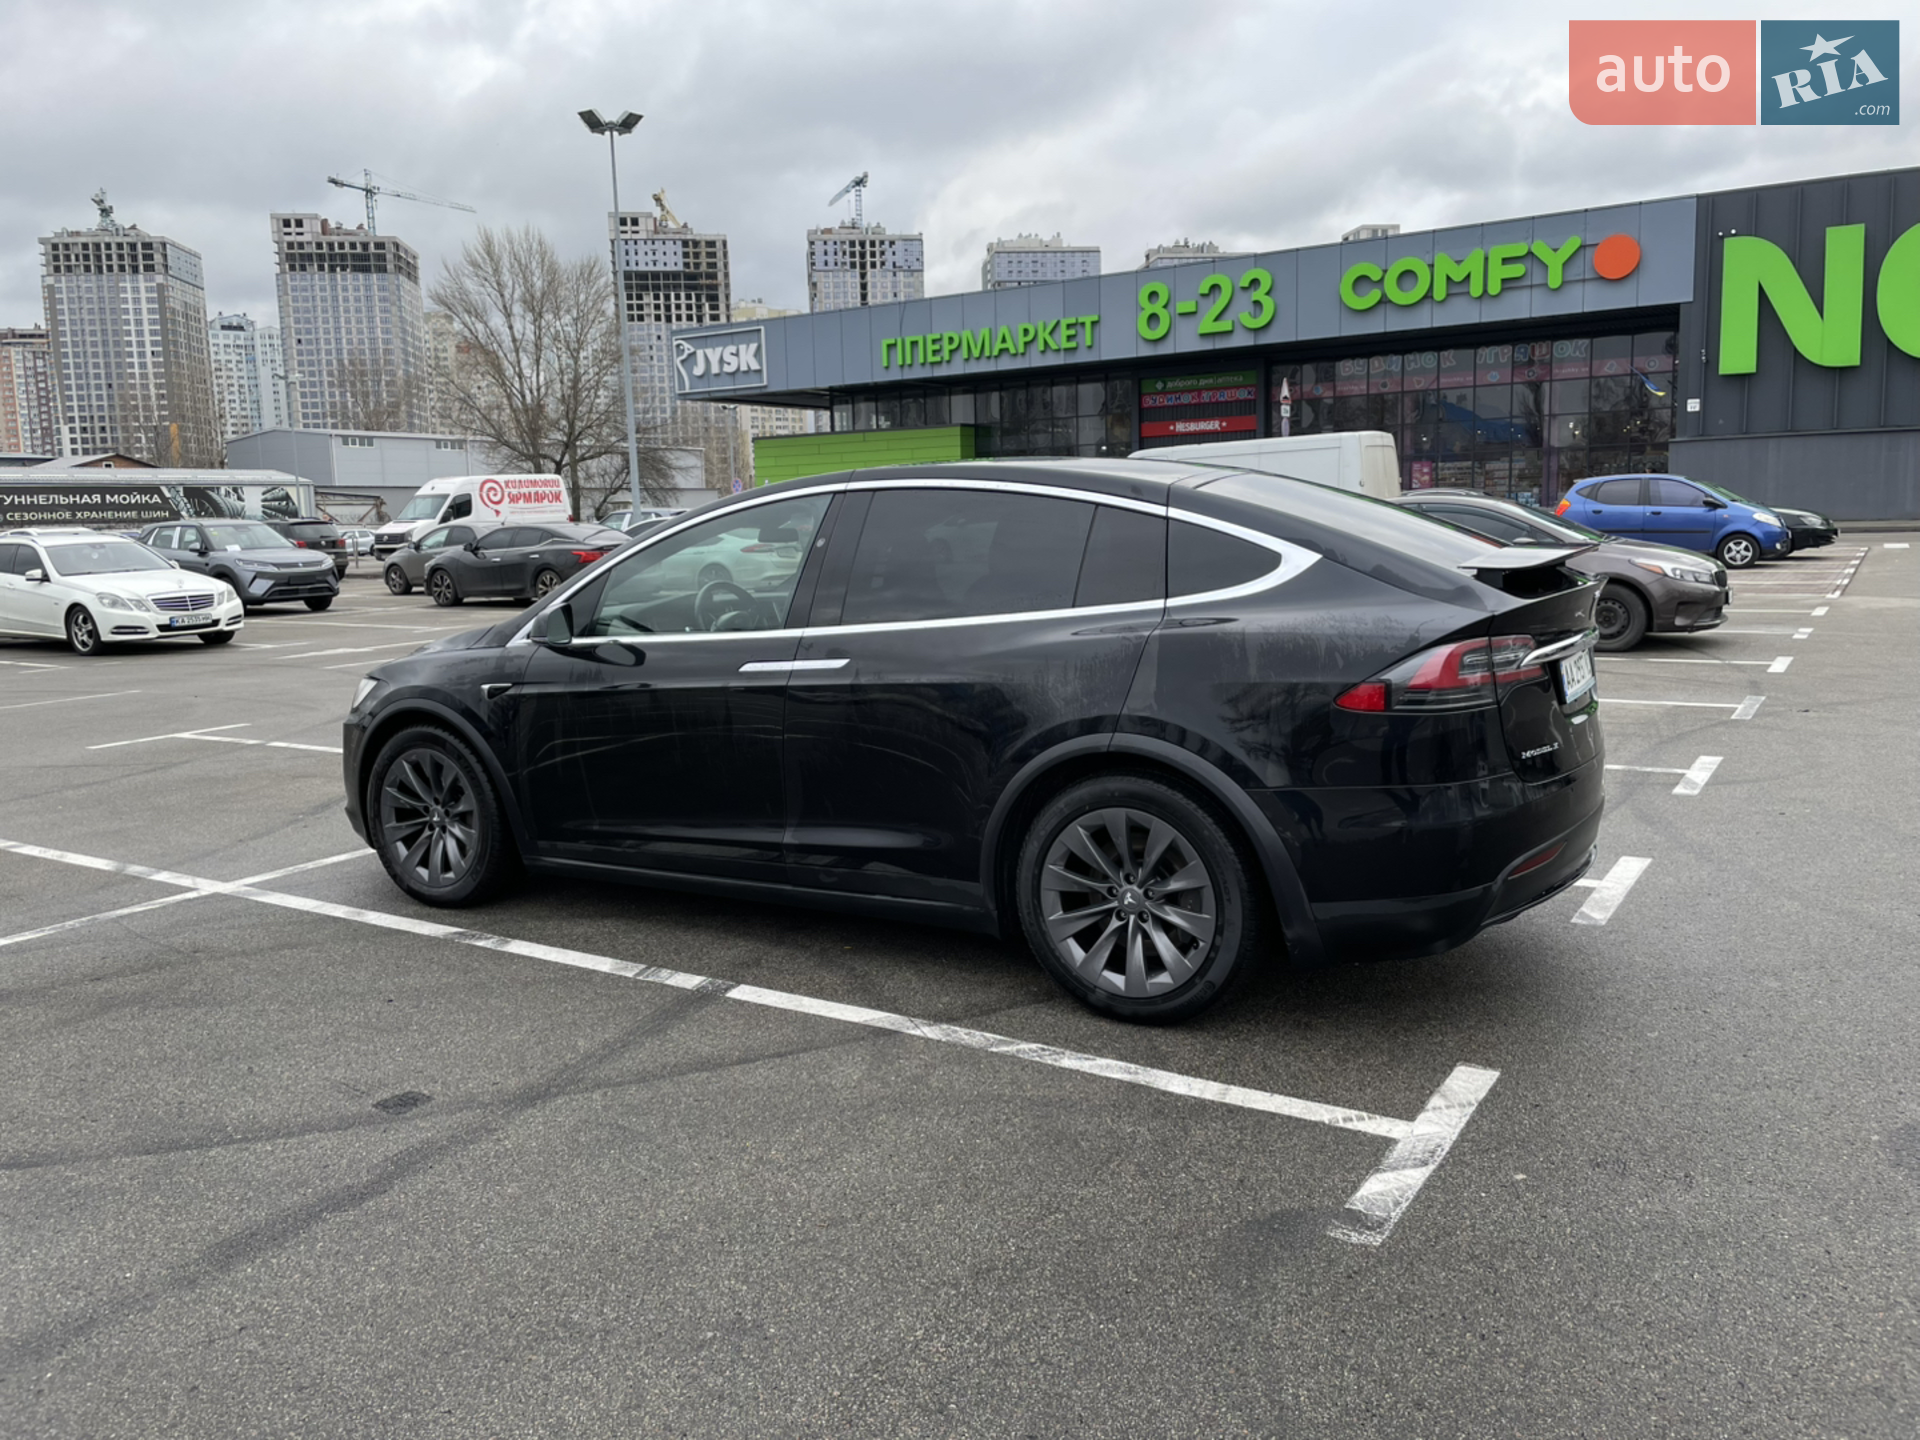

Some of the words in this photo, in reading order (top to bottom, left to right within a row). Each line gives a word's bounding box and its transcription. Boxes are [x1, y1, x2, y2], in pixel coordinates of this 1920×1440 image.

[1340, 235, 1582, 310] COMFY
[1137, 267, 1277, 341] 8-23
[881, 314, 1100, 368] ГІПЕРМАРКЕТ
[692, 342, 762, 377] JYSK
[1340, 349, 1456, 376] БУДИНОК
[1165, 378, 1198, 389] доброго
[1217, 375, 1244, 384] аптека
[1142, 390, 1199, 406] БУДИНОК
[1175, 420, 1221, 432] HESBURGER
[105, 492, 162, 504] МОЙКА
[507, 490, 563, 504] ЯРМАРОК
[6, 511, 73, 521] СЕЗОННОЕ
[75, 510, 138, 520] ХРАНЕНИЕ
[140, 510, 169, 518] ШИН
